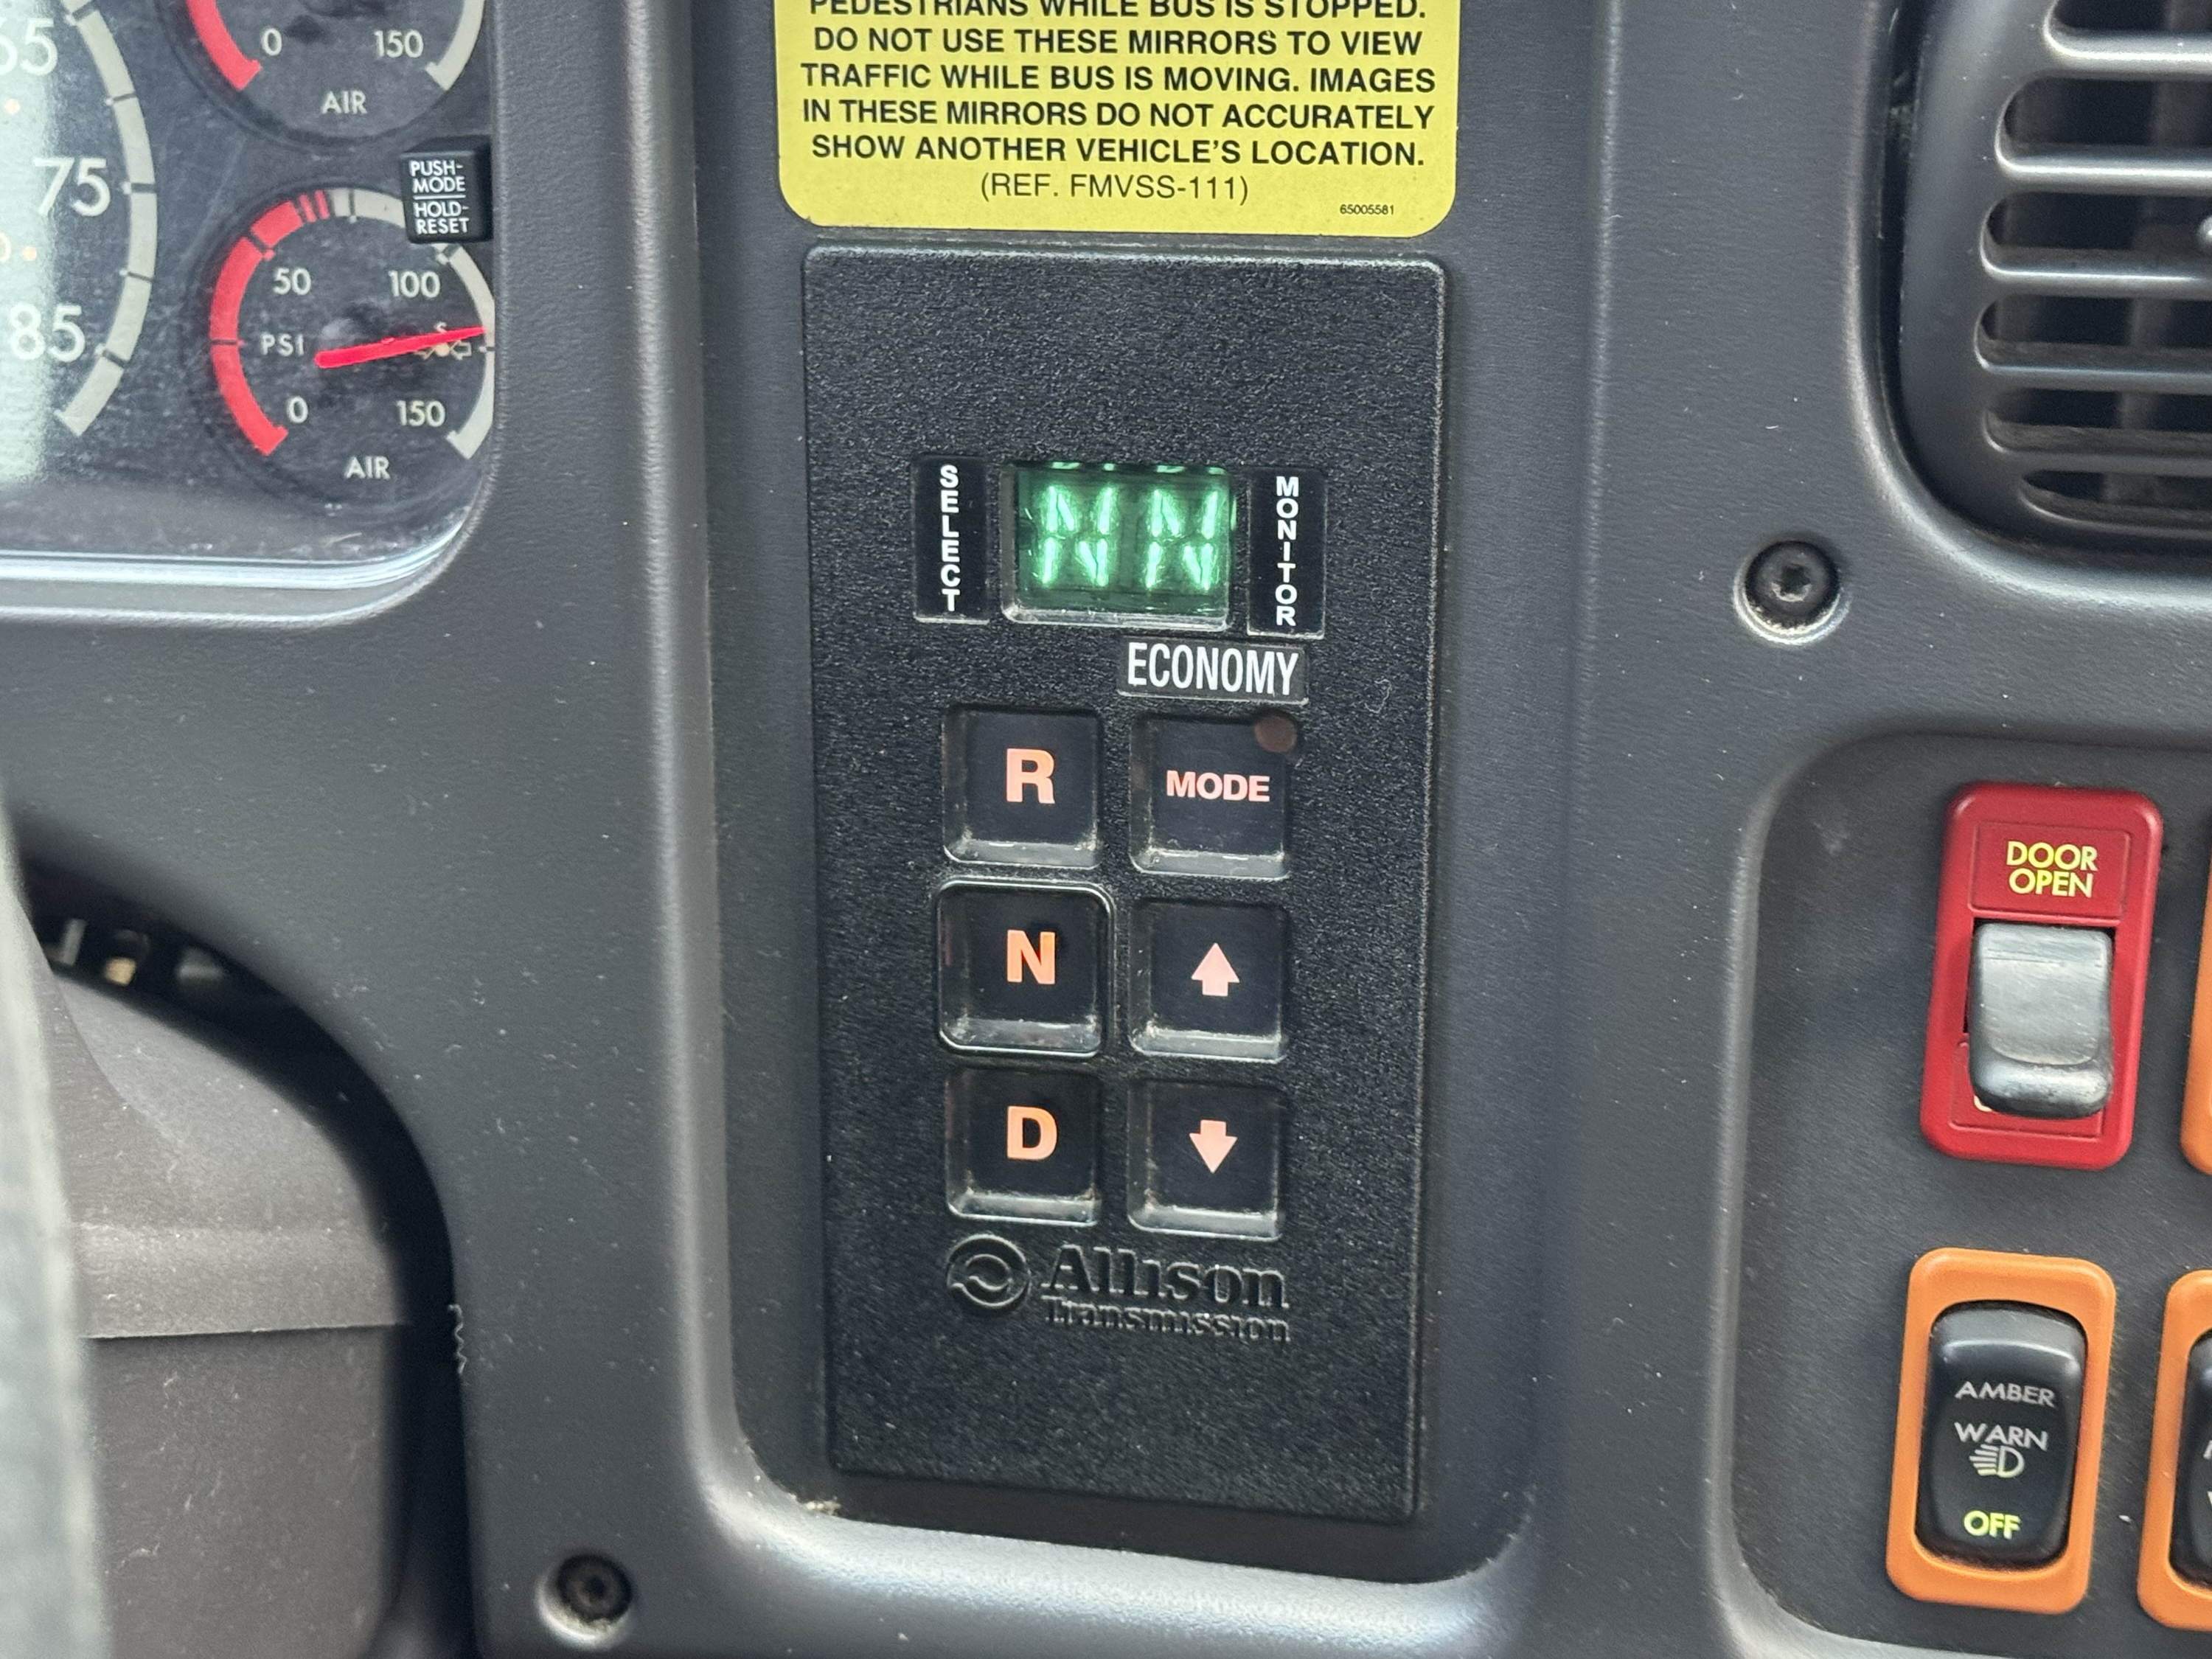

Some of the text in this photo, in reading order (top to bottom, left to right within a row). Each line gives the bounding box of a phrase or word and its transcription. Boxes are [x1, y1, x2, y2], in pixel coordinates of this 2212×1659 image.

[810, 0, 1426, 18] PEDESTRIANS WHILE BUS IS STOPPED.
[260, 27, 424, 58] 0 150
[815, 27, 1422, 56] DO NOT USE THESE MIRRORS TO VIEW
[800, 63, 1436, 93] TRAFFIC WHILE BUS IS MOVING. IMAGES
[321, 90, 367, 114] AIR
[803, 99, 1435, 129] IN THESE MIRRORS DO NOT ACCURATELY
[813, 134, 1424, 166] SHOW ANOTHER VEHICLE'S LOCATION.
[409, 159, 464, 177] PUSH-
[34, 157, 111, 217] 75
[412, 176, 466, 193] MODE
[981, 173, 1248, 206] (REF. FMVSS-111)
[413, 201, 470, 218] HOLD-
[1340, 204, 1395, 215] 65005581
[415, 217, 470, 234] RESET
[274, 268, 441, 299] 50 100
[10, 302, 86, 363] 85
[260, 332, 305, 356] PSI
[287, 396, 445, 427] 0 150
[344, 456, 391, 480] AIR
[939, 465, 961, 612] SELECT
[1275, 476, 1300, 627] MONITOR
[1127, 641, 1299, 695] ECONOMY
[1006, 748, 1055, 804] R
[1166, 770, 1270, 802] MODE
[2006, 841, 2098, 872] DOOR
[2008, 868, 2094, 898] OPEN
[1006, 929, 1056, 985] N
[1006, 1105, 1058, 1161] D
[1040, 1244, 1290, 1309] Allison
[1040, 1295, 1291, 1342] Transmission
[1955, 1381, 2056, 1408] AMBER
[1954, 1422, 2048, 1452] WARN
[1964, 1510, 2021, 1540] OFF
